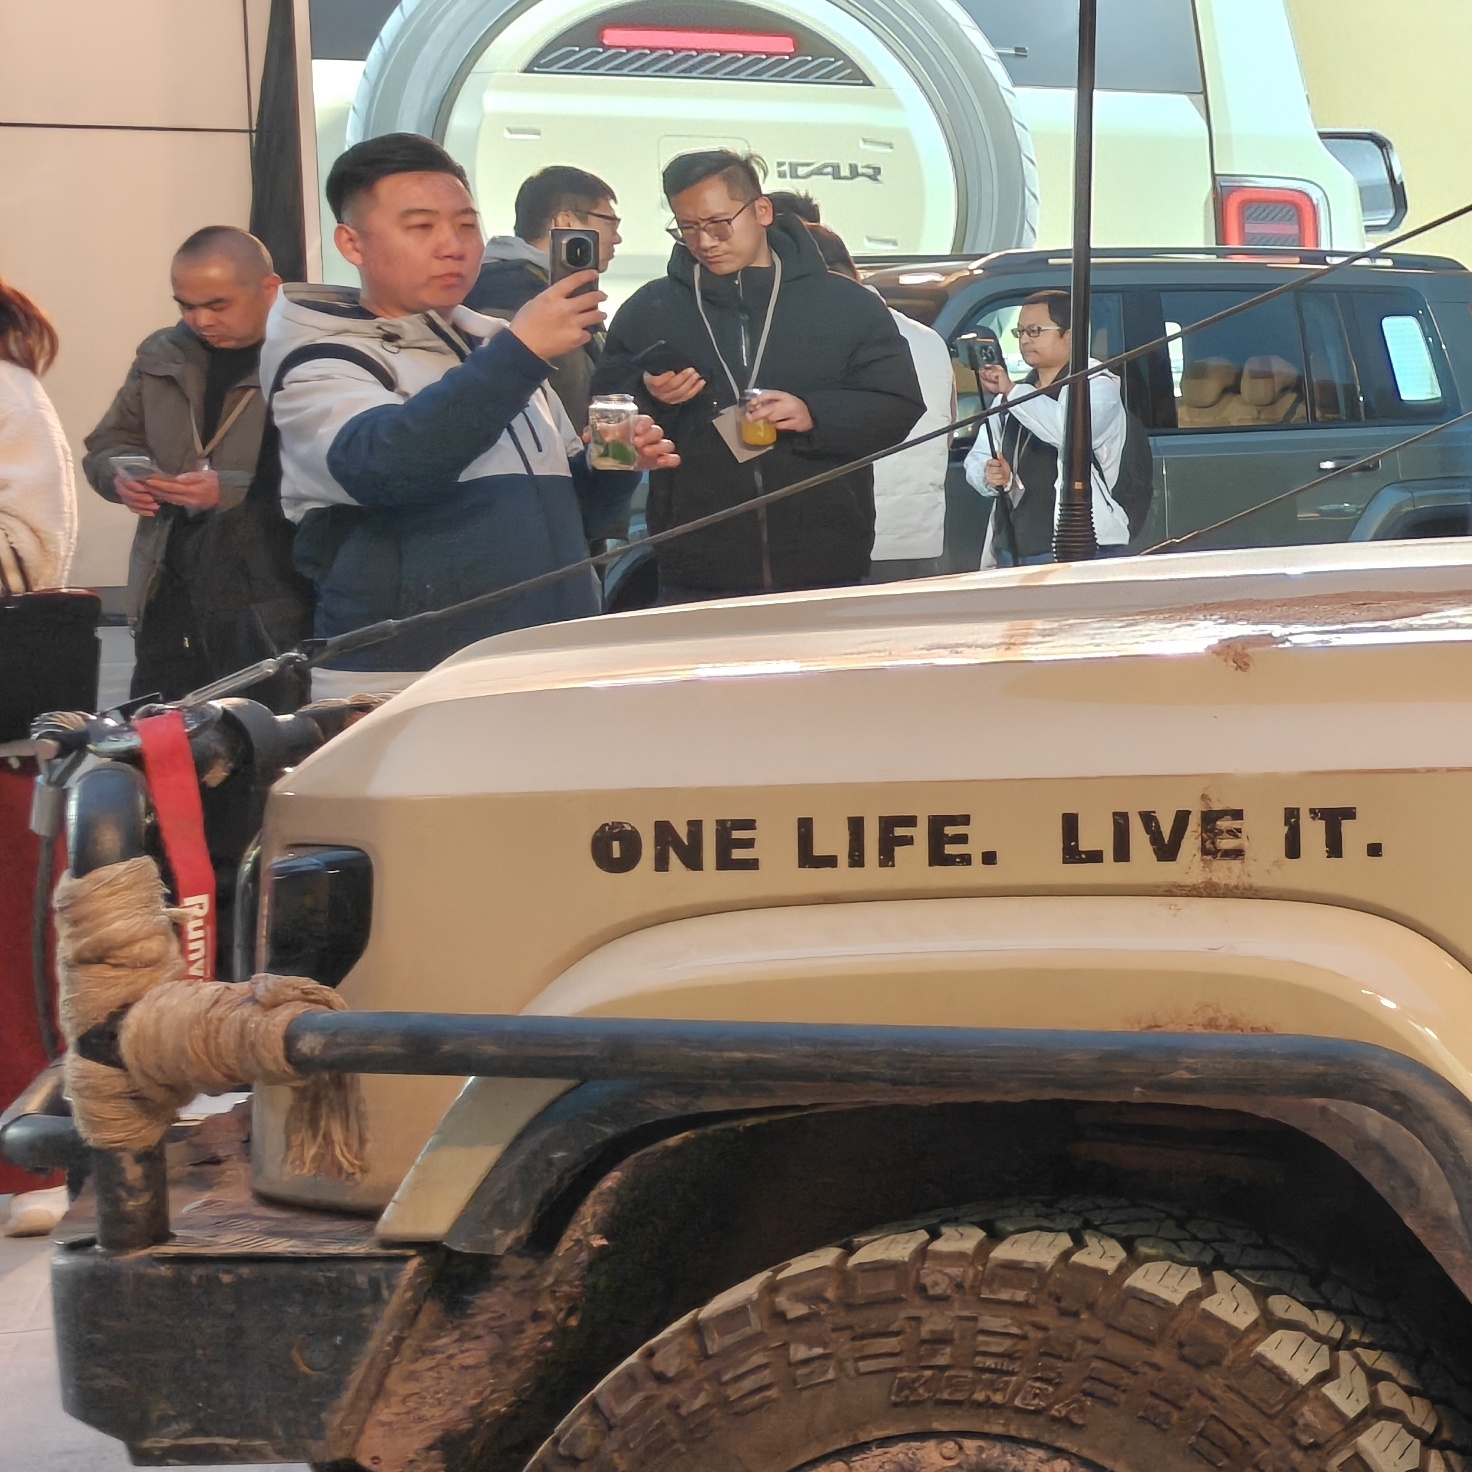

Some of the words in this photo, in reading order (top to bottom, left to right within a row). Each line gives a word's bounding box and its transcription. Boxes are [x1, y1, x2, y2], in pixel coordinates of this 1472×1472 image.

[591, 818, 760, 874] ONE
[798, 814, 998, 870] LIFE.
[1061, 808, 1245, 865] LIVE
[1284, 806, 1384, 860] IT.
[183, 894, 210, 981] Runv
